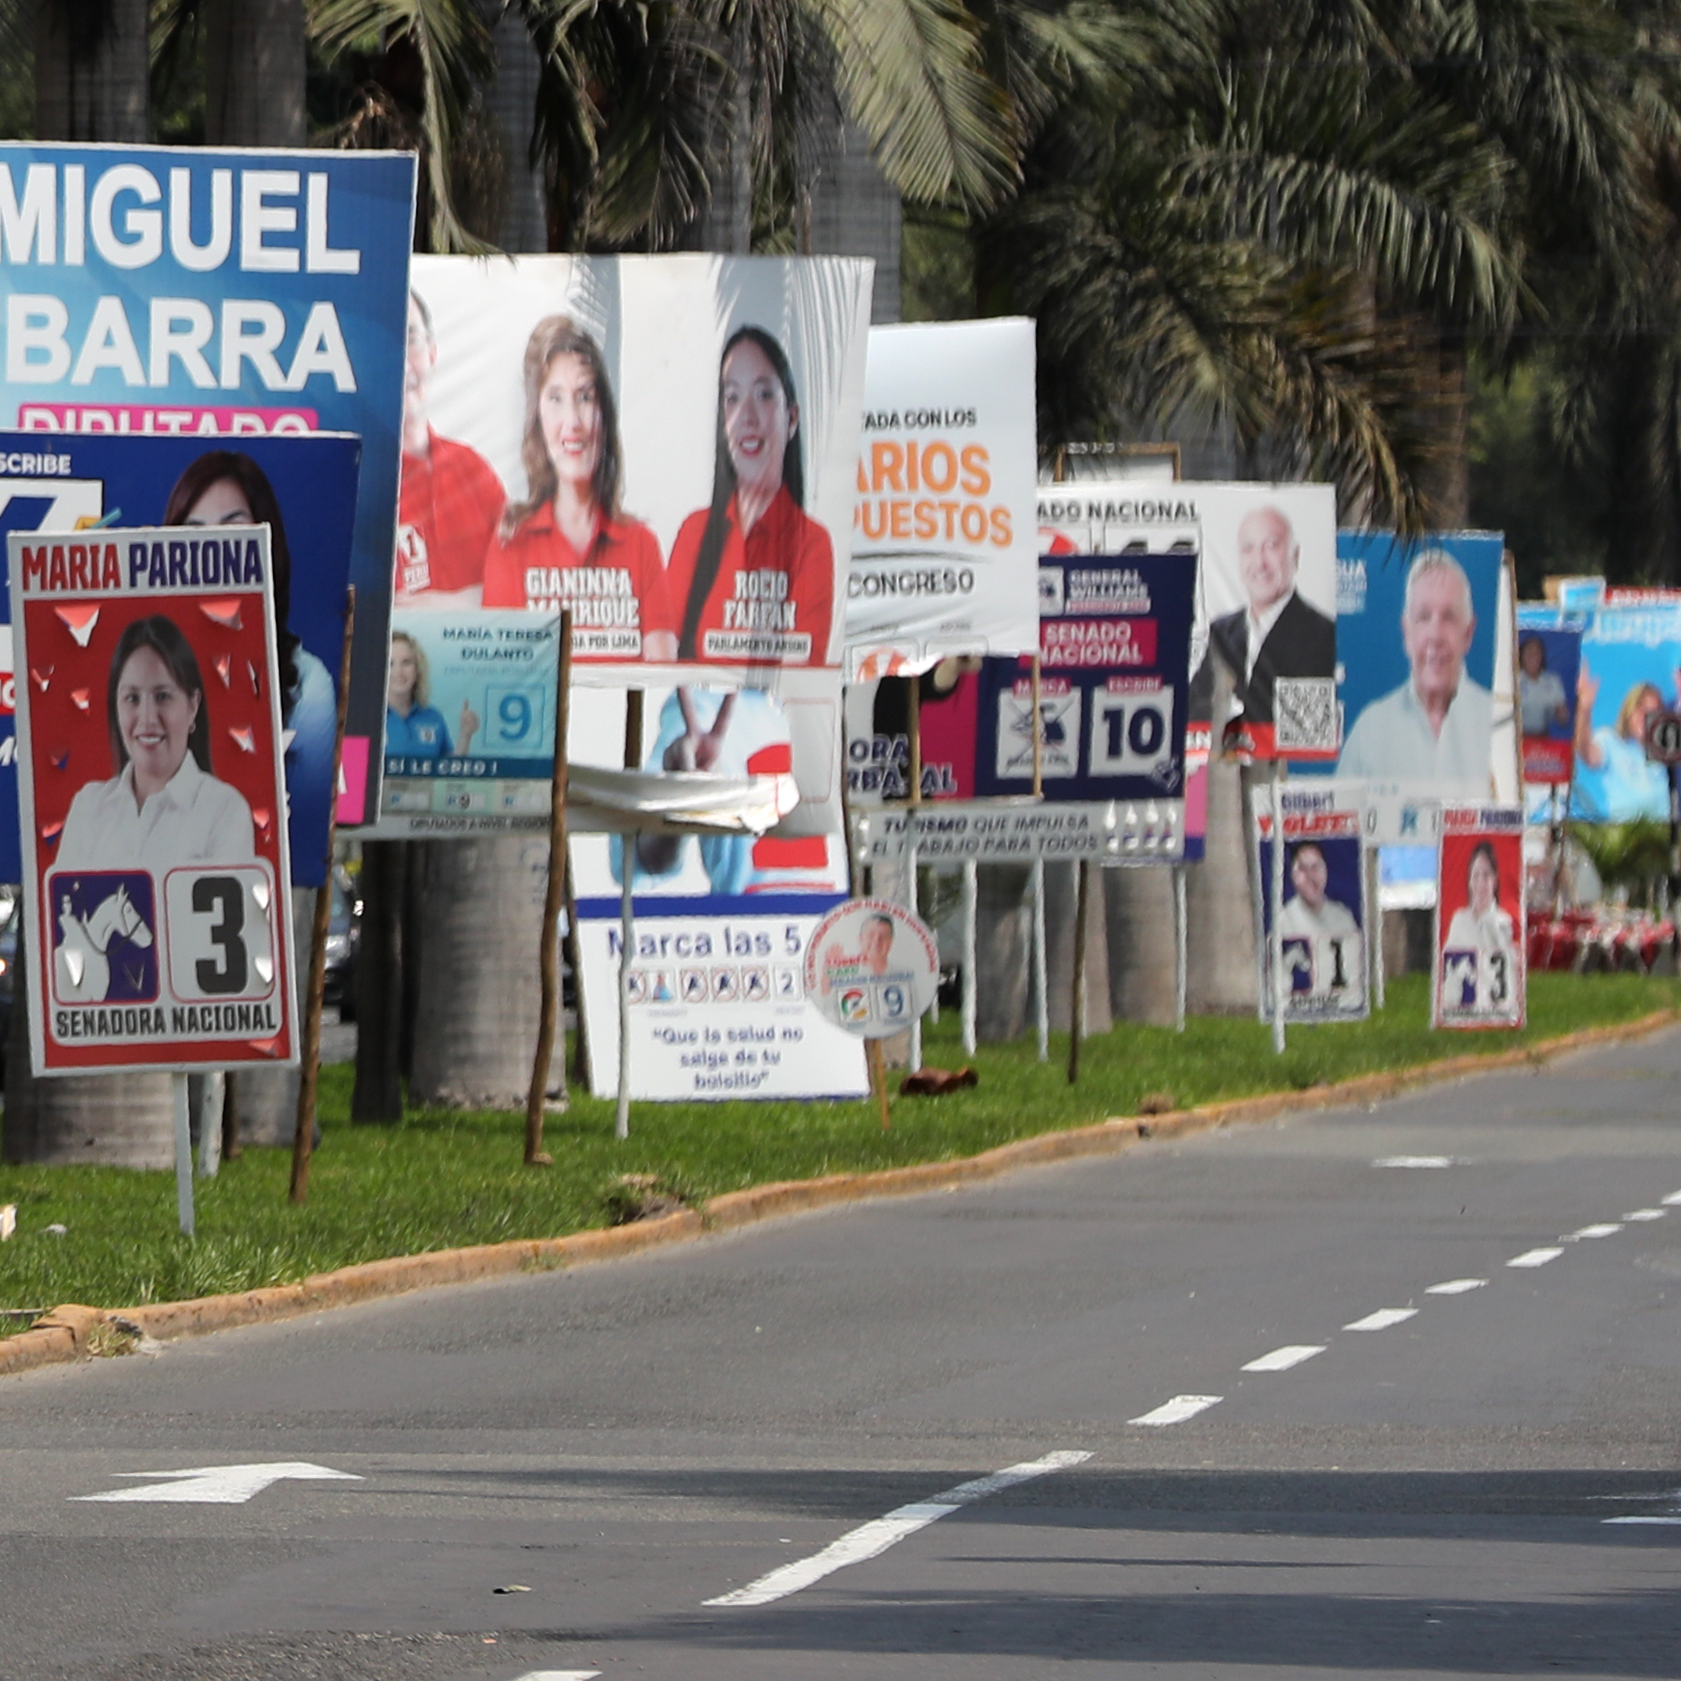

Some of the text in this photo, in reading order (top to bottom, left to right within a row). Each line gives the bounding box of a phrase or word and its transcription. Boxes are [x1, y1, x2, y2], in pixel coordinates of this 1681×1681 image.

[904, 406, 978, 429] CON LOS
[854, 499, 1014, 549] UESTOS
[1089, 499, 1198, 520] NACIONAL
[22, 539, 264, 591] MARIA PARIONA
[847, 569, 975, 598] CONGRESO
[1044, 622, 1133, 643] SENADO
[1038, 642, 1144, 666] NACIONAL
[499, 693, 532, 743] 9
[1102, 708, 1165, 760] 10
[192, 876, 248, 994] 3
[725, 924, 803, 956] las 5
[1330, 938, 1347, 988] 1
[1490, 951, 1507, 1003] 3
[781, 973, 793, 994] 2
[884, 985, 903, 1017] 9
[56, 1002, 277, 1039] SENADORA NACIONAL
